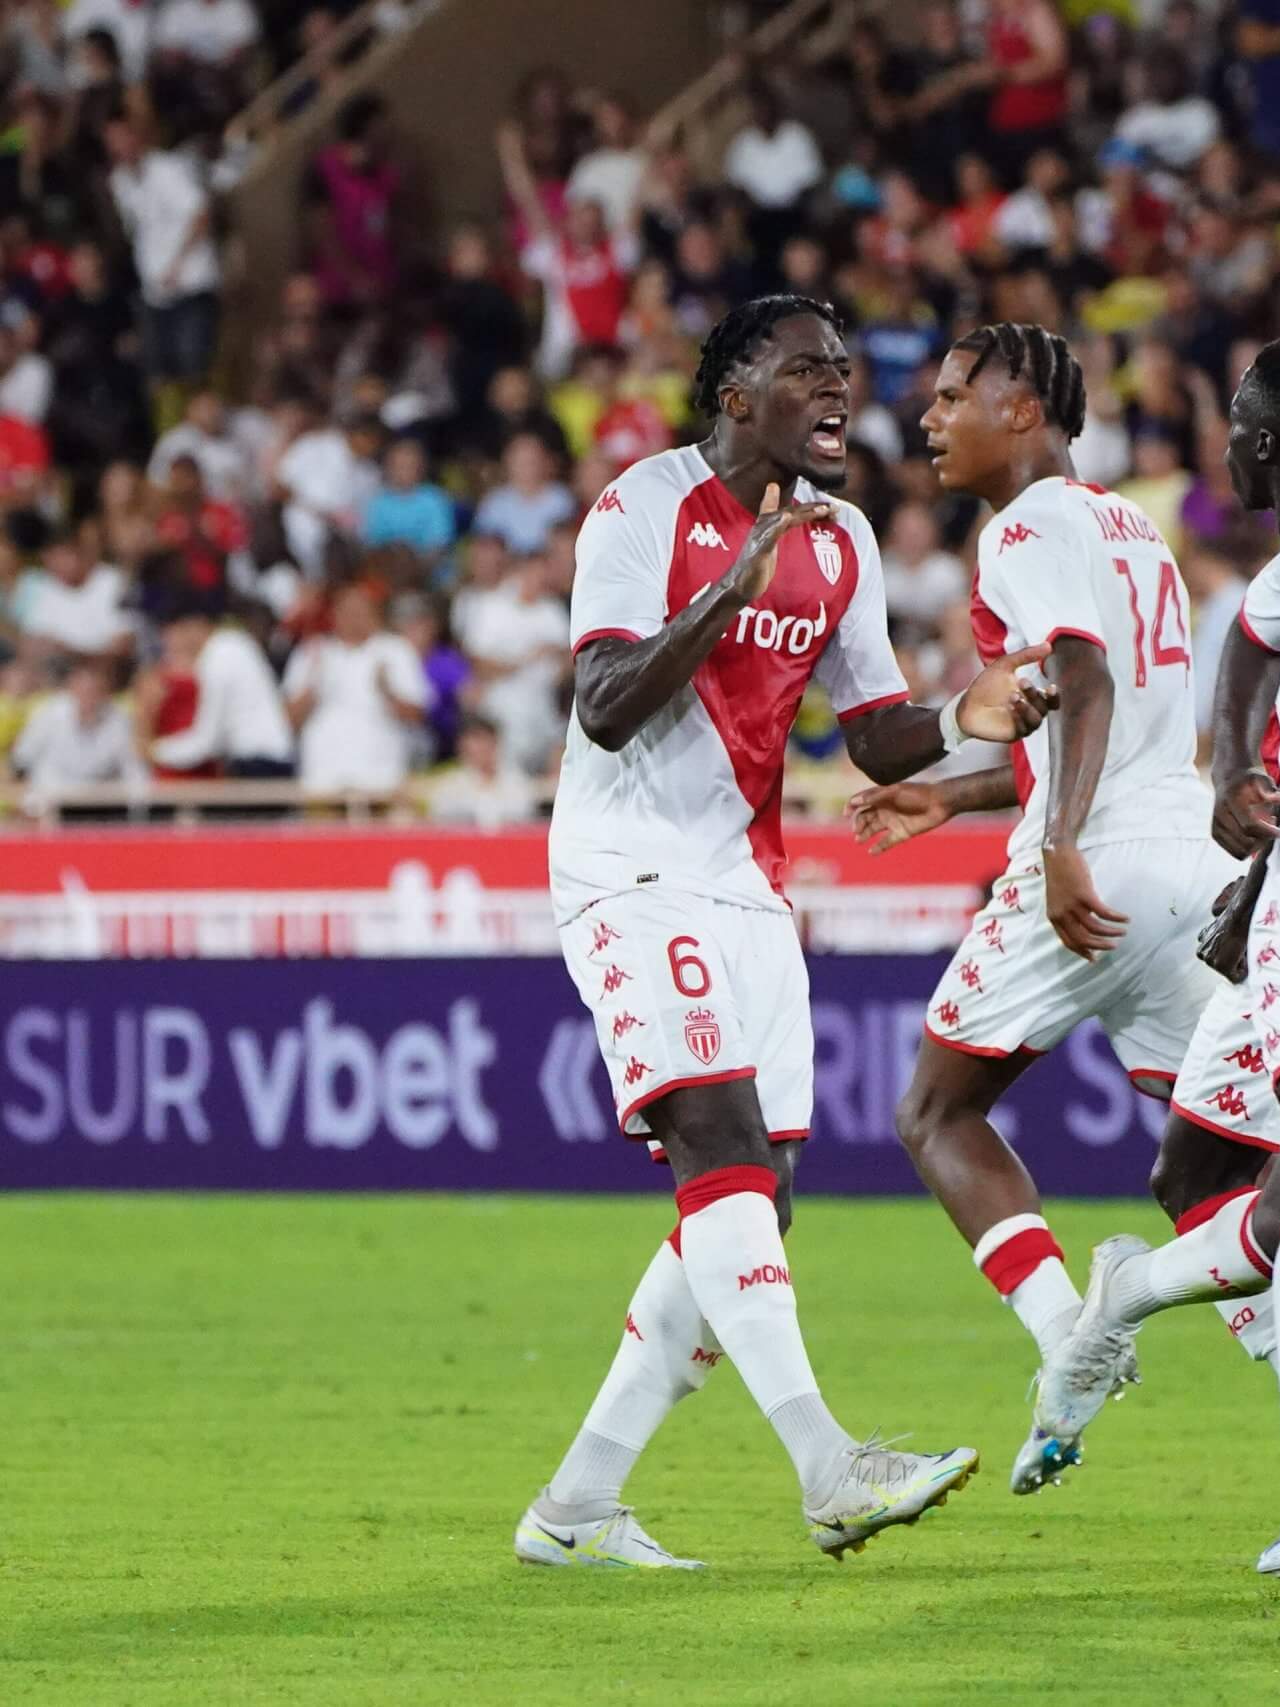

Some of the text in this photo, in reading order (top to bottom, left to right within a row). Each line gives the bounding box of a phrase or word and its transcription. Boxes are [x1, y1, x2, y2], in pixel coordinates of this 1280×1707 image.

[1112, 557, 1190, 688] 14
[667, 935, 711, 998] 6
[4, 996, 499, 1150] SUR vbet
[738, 1264, 792, 1291] MON
